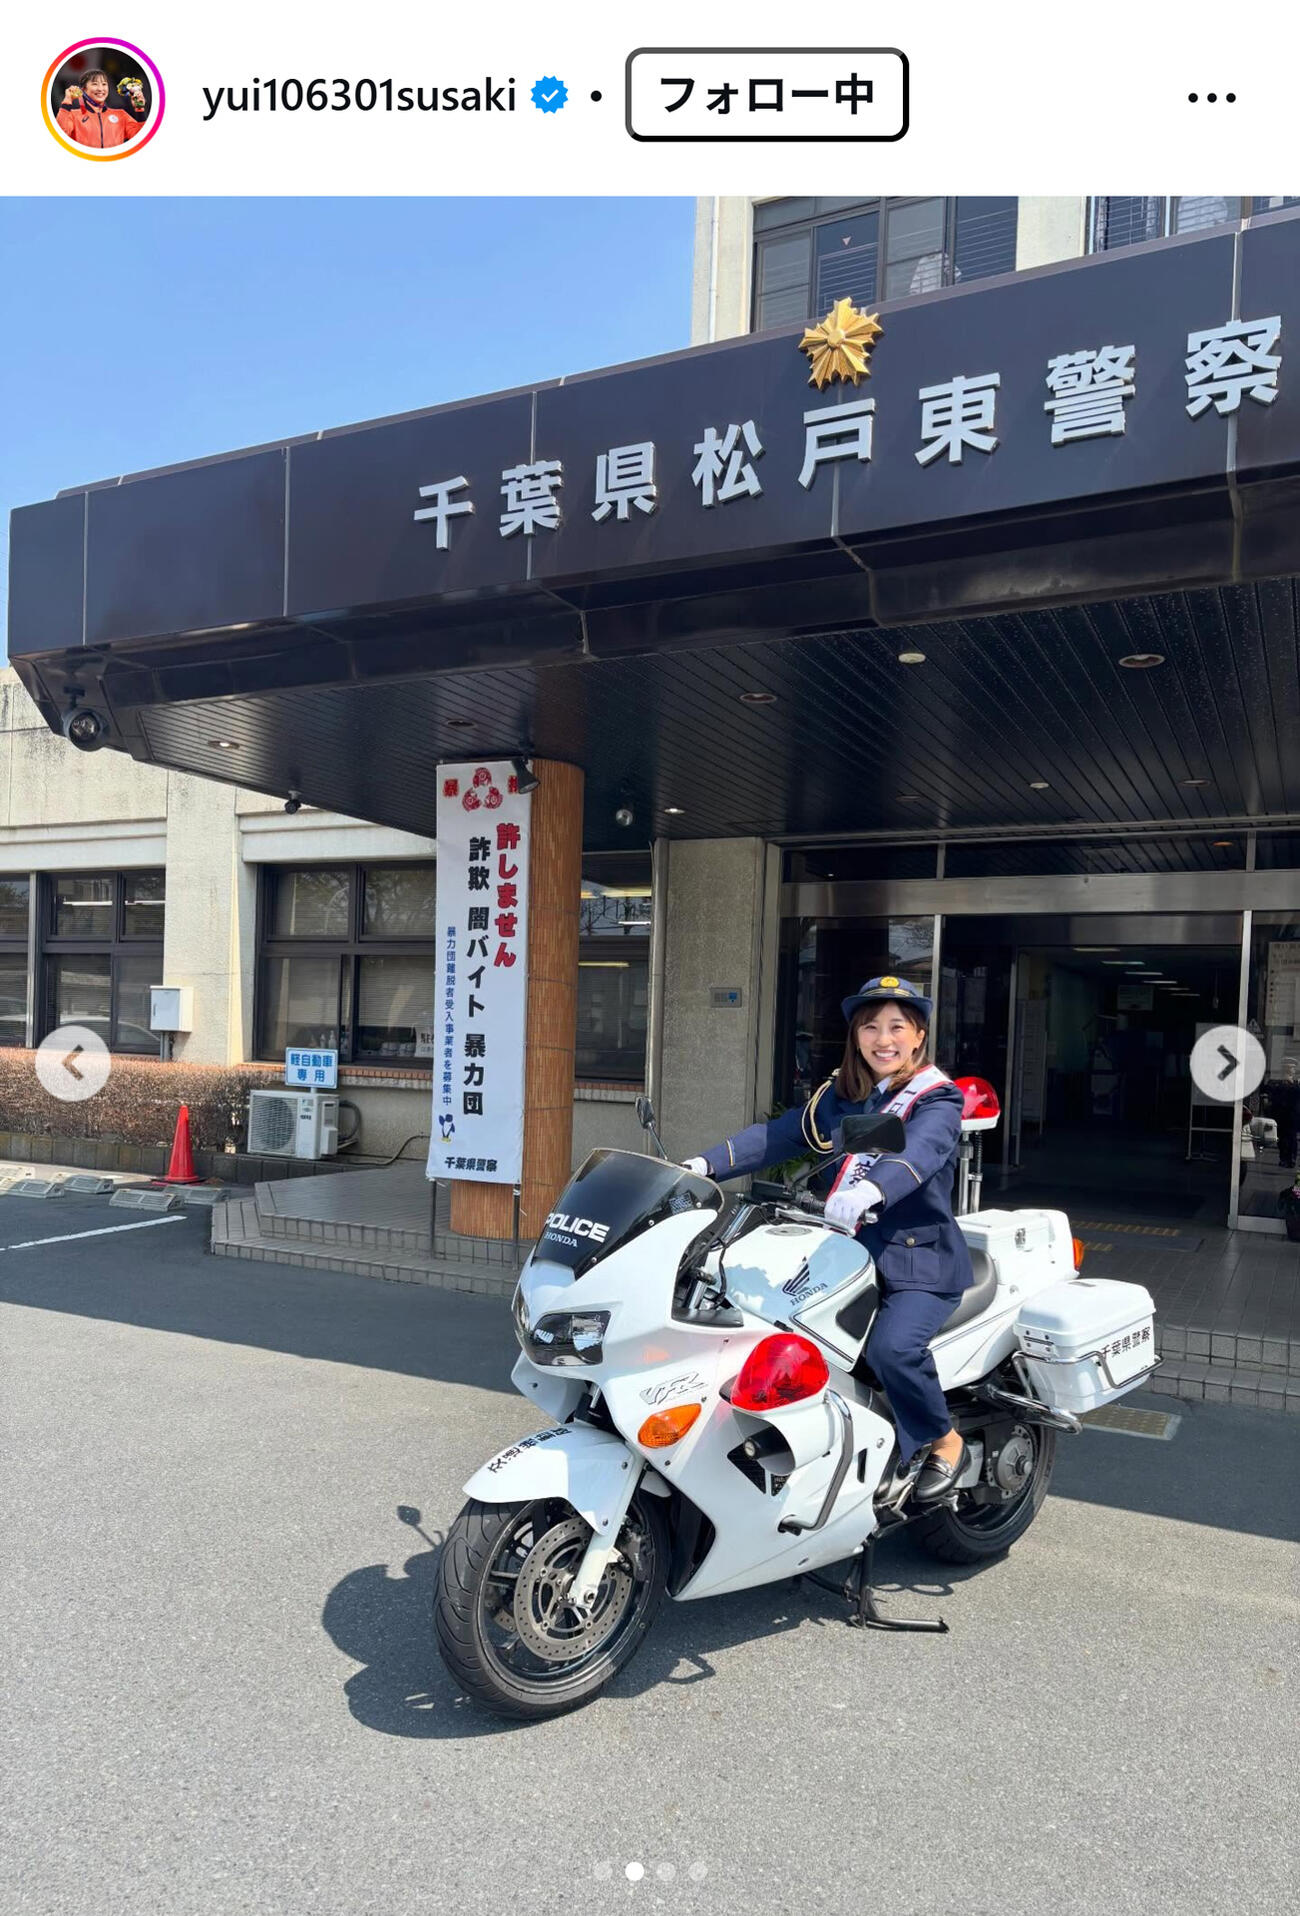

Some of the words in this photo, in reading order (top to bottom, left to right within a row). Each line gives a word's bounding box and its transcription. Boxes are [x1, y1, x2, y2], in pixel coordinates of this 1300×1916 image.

[414, 314, 1282, 551] 千葉県松戸東警察
[468, 837, 491, 891] 詐欺
[494, 823, 521, 968] 許しません
[466, 907, 490, 1018] 闇バイト
[442, 926, 457, 1106] 暴力団離脱者受入事業者を募集中
[290, 1053, 333, 1067] 軽自動車
[297, 1069, 325, 1082] 専用
[463, 1034, 486, 1116] 暴力団
[444, 1156, 498, 1172] 千葉県警察
[544, 1231, 578, 1247] HONDA
[545, 1213, 611, 1243] POLICE
[790, 1283, 828, 1306] HONDA
[1101, 1326, 1151, 1358] 千葉県警察
